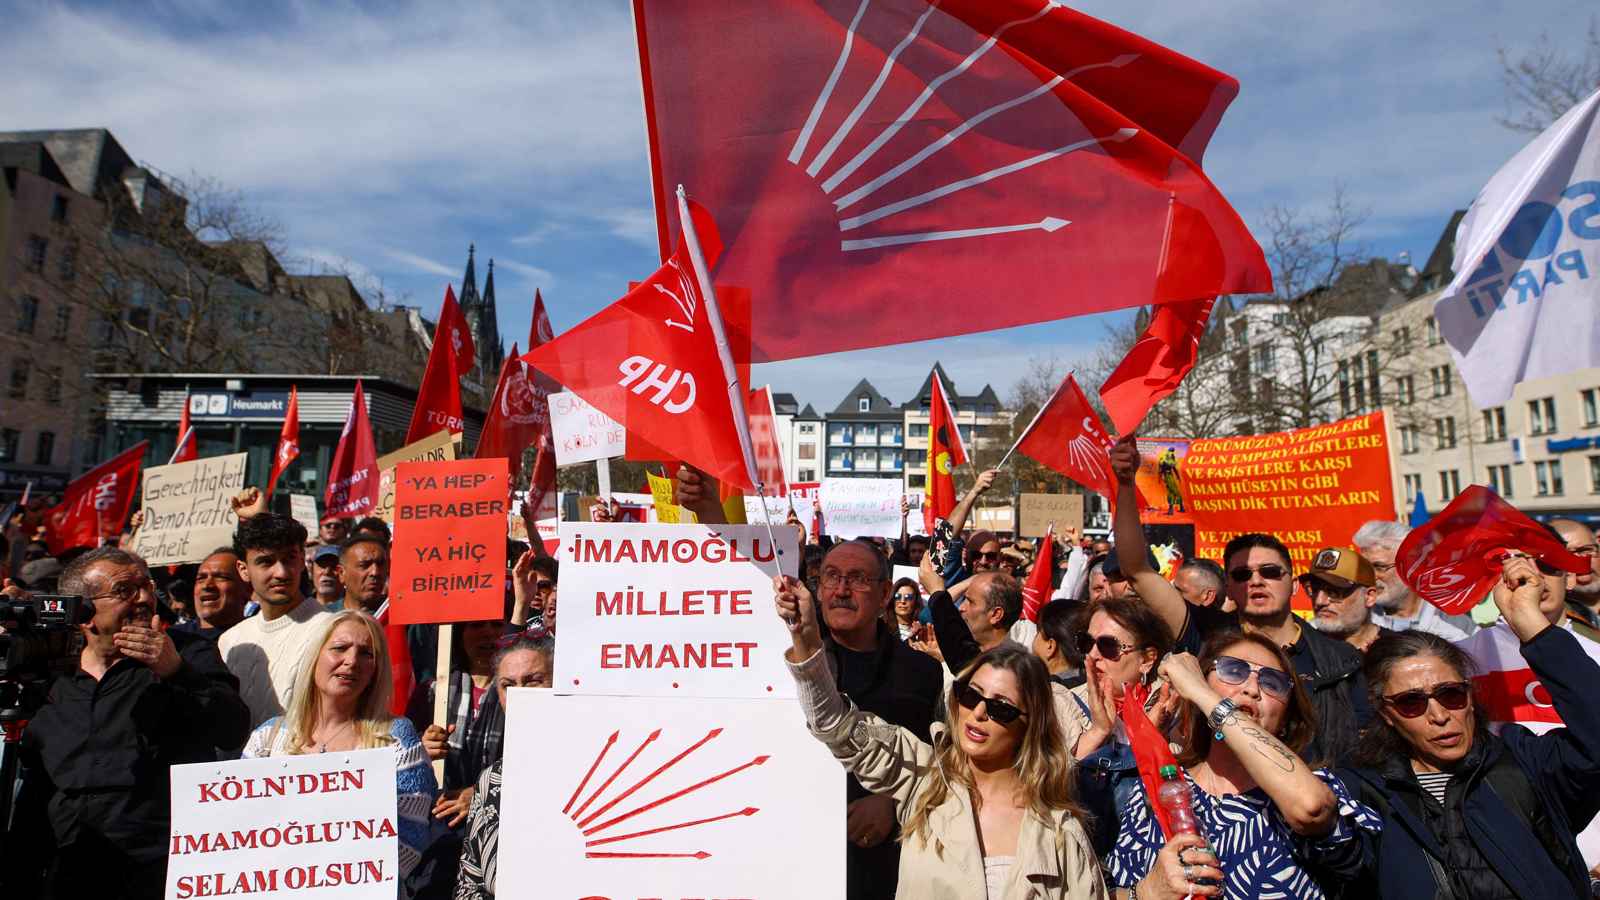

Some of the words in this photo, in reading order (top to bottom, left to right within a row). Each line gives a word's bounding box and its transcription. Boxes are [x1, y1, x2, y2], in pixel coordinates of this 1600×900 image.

[233, 399, 283, 410] Heumarkt
[1191, 435, 1284, 453] GÜNÜMÜZÜN
[1288, 415, 1370, 446] YEZİDLERİ
[1187, 452, 1229, 466] OLAN
[1231, 434, 1383, 464] EMPERYALİSTLERE
[144, 455, 245, 504] Gerechtigkeit
[1185, 467, 1205, 480] VE
[1206, 461, 1296, 480] FAŞİSTLERE
[1300, 455, 1353, 474] KARŞI
[412, 475, 438, 491] YA
[444, 474, 487, 489] HEP
[1189, 481, 1228, 496] İMAM
[1230, 474, 1299, 494] HÜSEYİN
[1302, 472, 1340, 490] GİBİ
[400, 500, 504, 520] BERABER
[1193, 498, 1237, 513] BAŞINI
[1239, 495, 1266, 511] DİK
[1269, 490, 1381, 509] TUTANLARIN
[573, 532, 776, 564] İMAMOĞLU
[1199, 531, 1218, 543] VE
[415, 546, 443, 563] YA
[448, 541, 487, 563] HİÇ
[411, 571, 495, 593] BİRİMİZ
[595, 585, 753, 616] MİLLETE
[600, 642, 758, 669] EMANET
[197, 768, 366, 804] KÖLN'DEN
[170, 817, 398, 855] İMAMOĞLU'NA
[176, 869, 279, 899] SELAM
